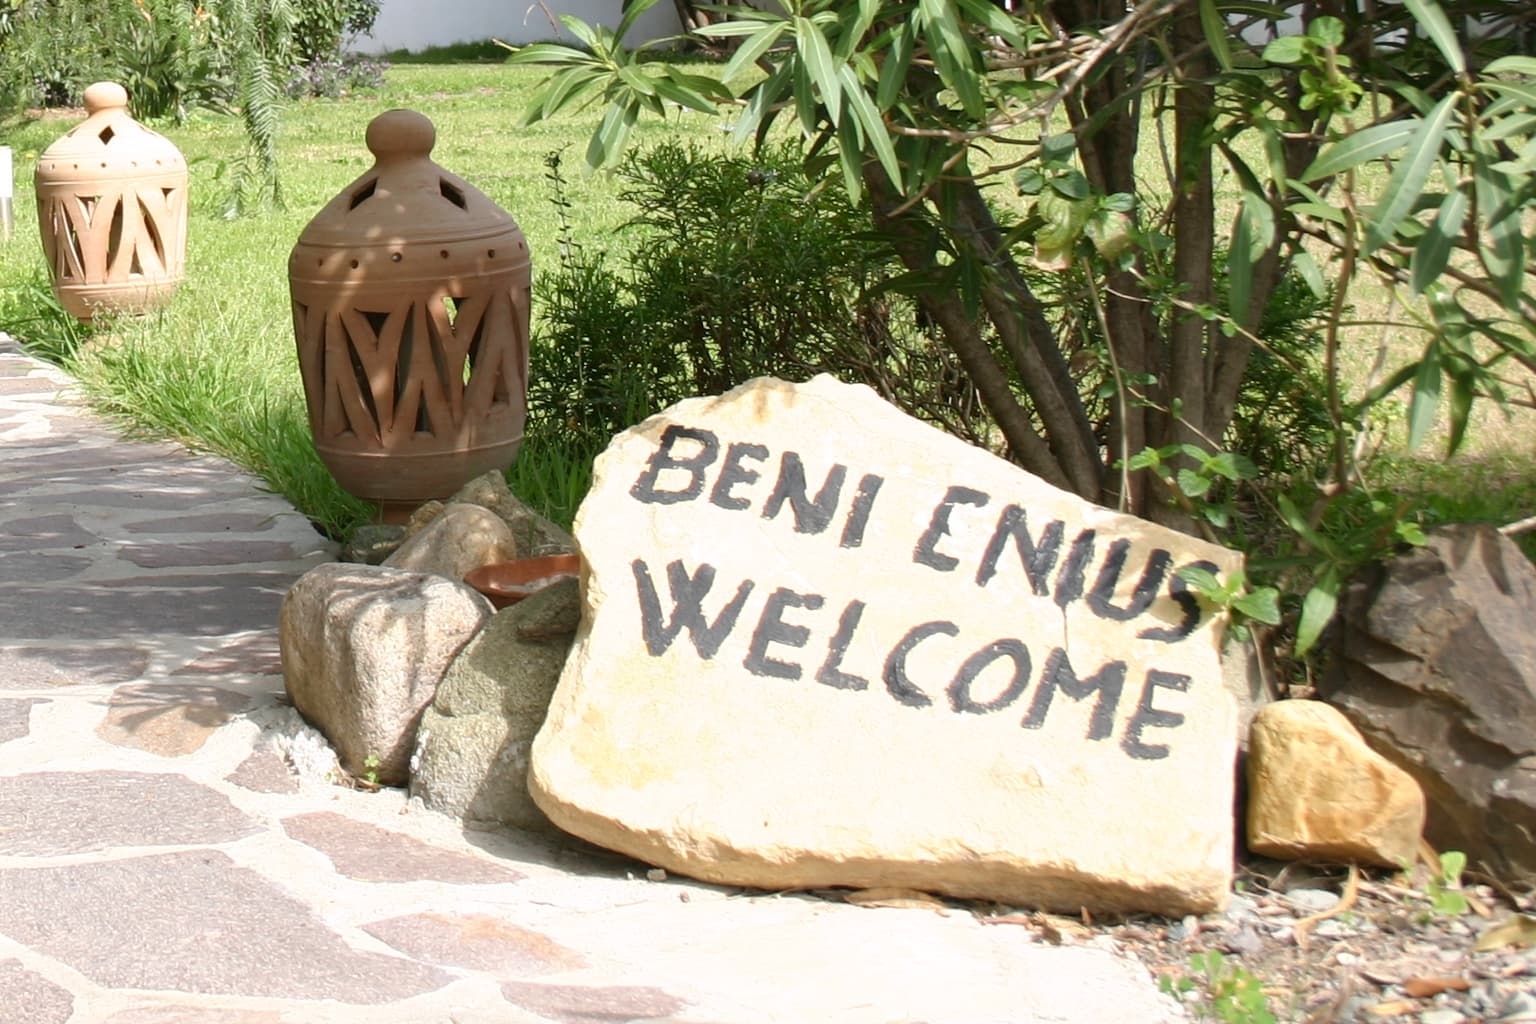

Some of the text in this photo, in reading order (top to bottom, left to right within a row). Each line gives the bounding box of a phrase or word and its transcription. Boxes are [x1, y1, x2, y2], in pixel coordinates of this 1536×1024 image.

[630, 425, 1220, 643] BENI ENIUS
[632, 559, 1191, 759] WELCOME
